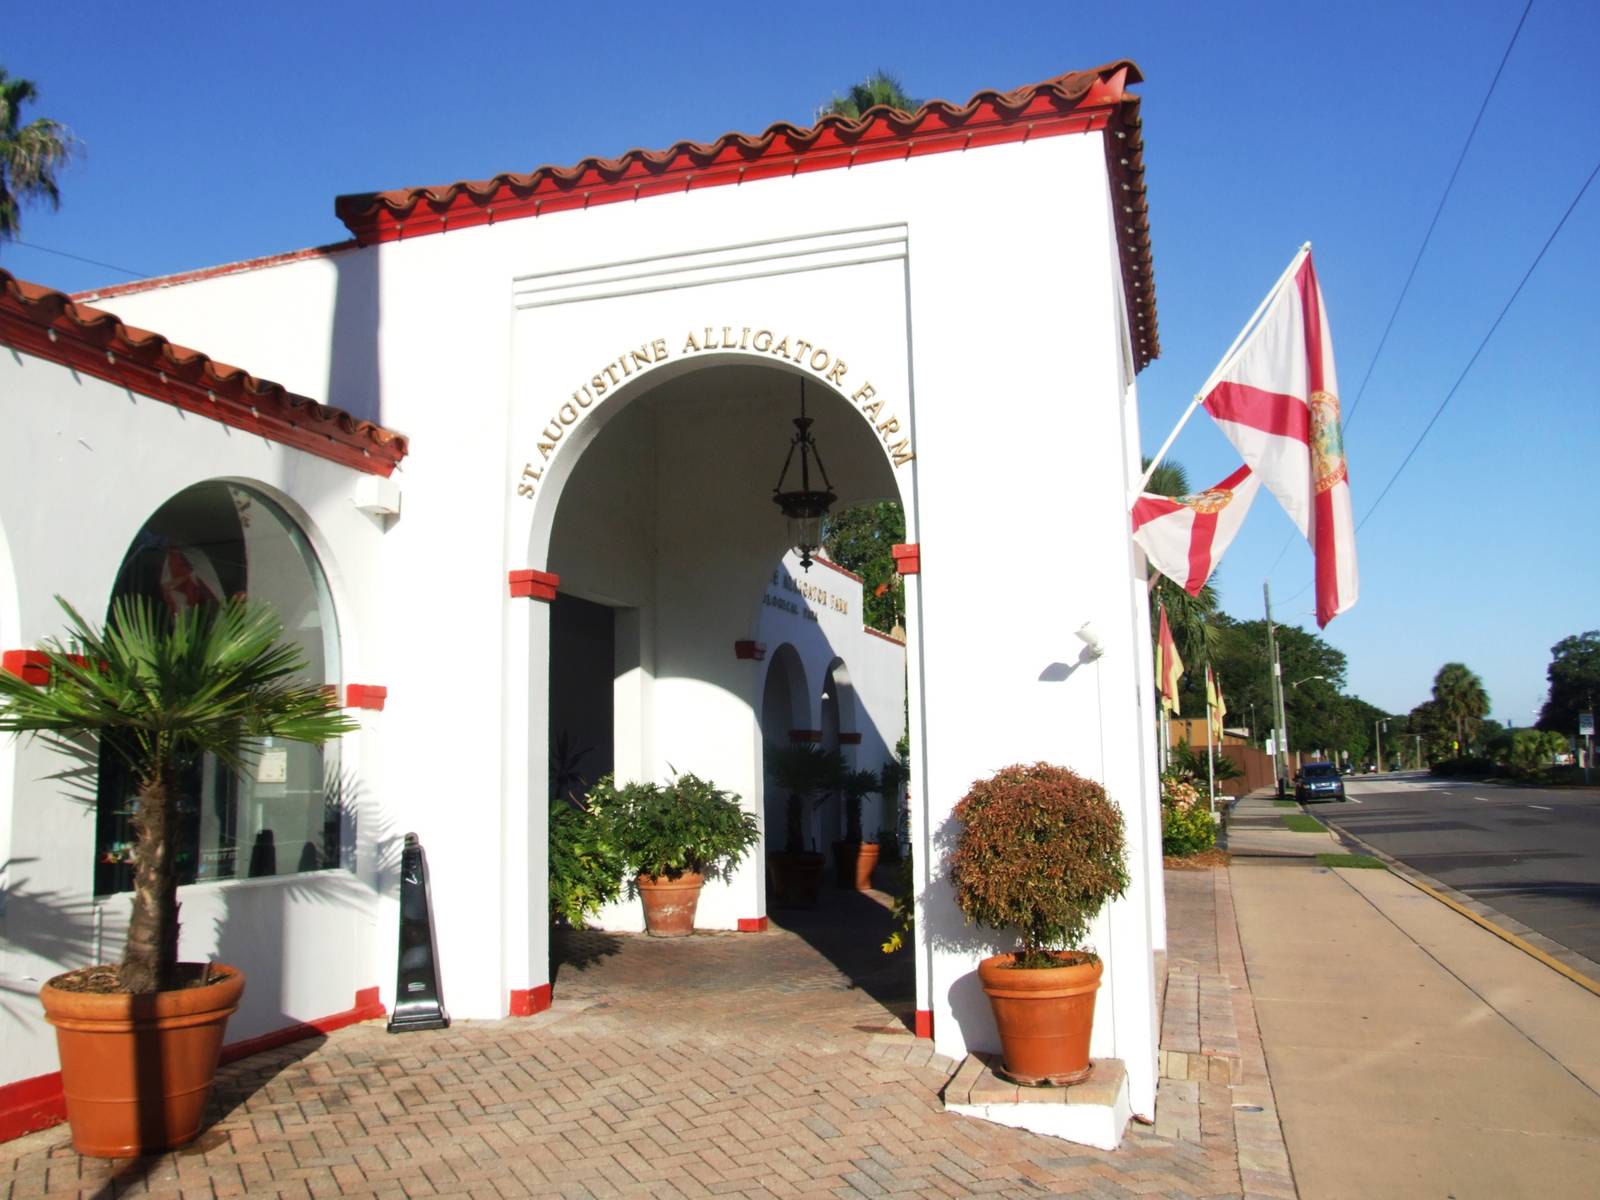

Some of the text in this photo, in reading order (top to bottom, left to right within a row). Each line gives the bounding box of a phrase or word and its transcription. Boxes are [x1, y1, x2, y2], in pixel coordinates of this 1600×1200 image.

[517, 326, 917, 499] ST. AUGUSTINE ALLIGATOR FARM
